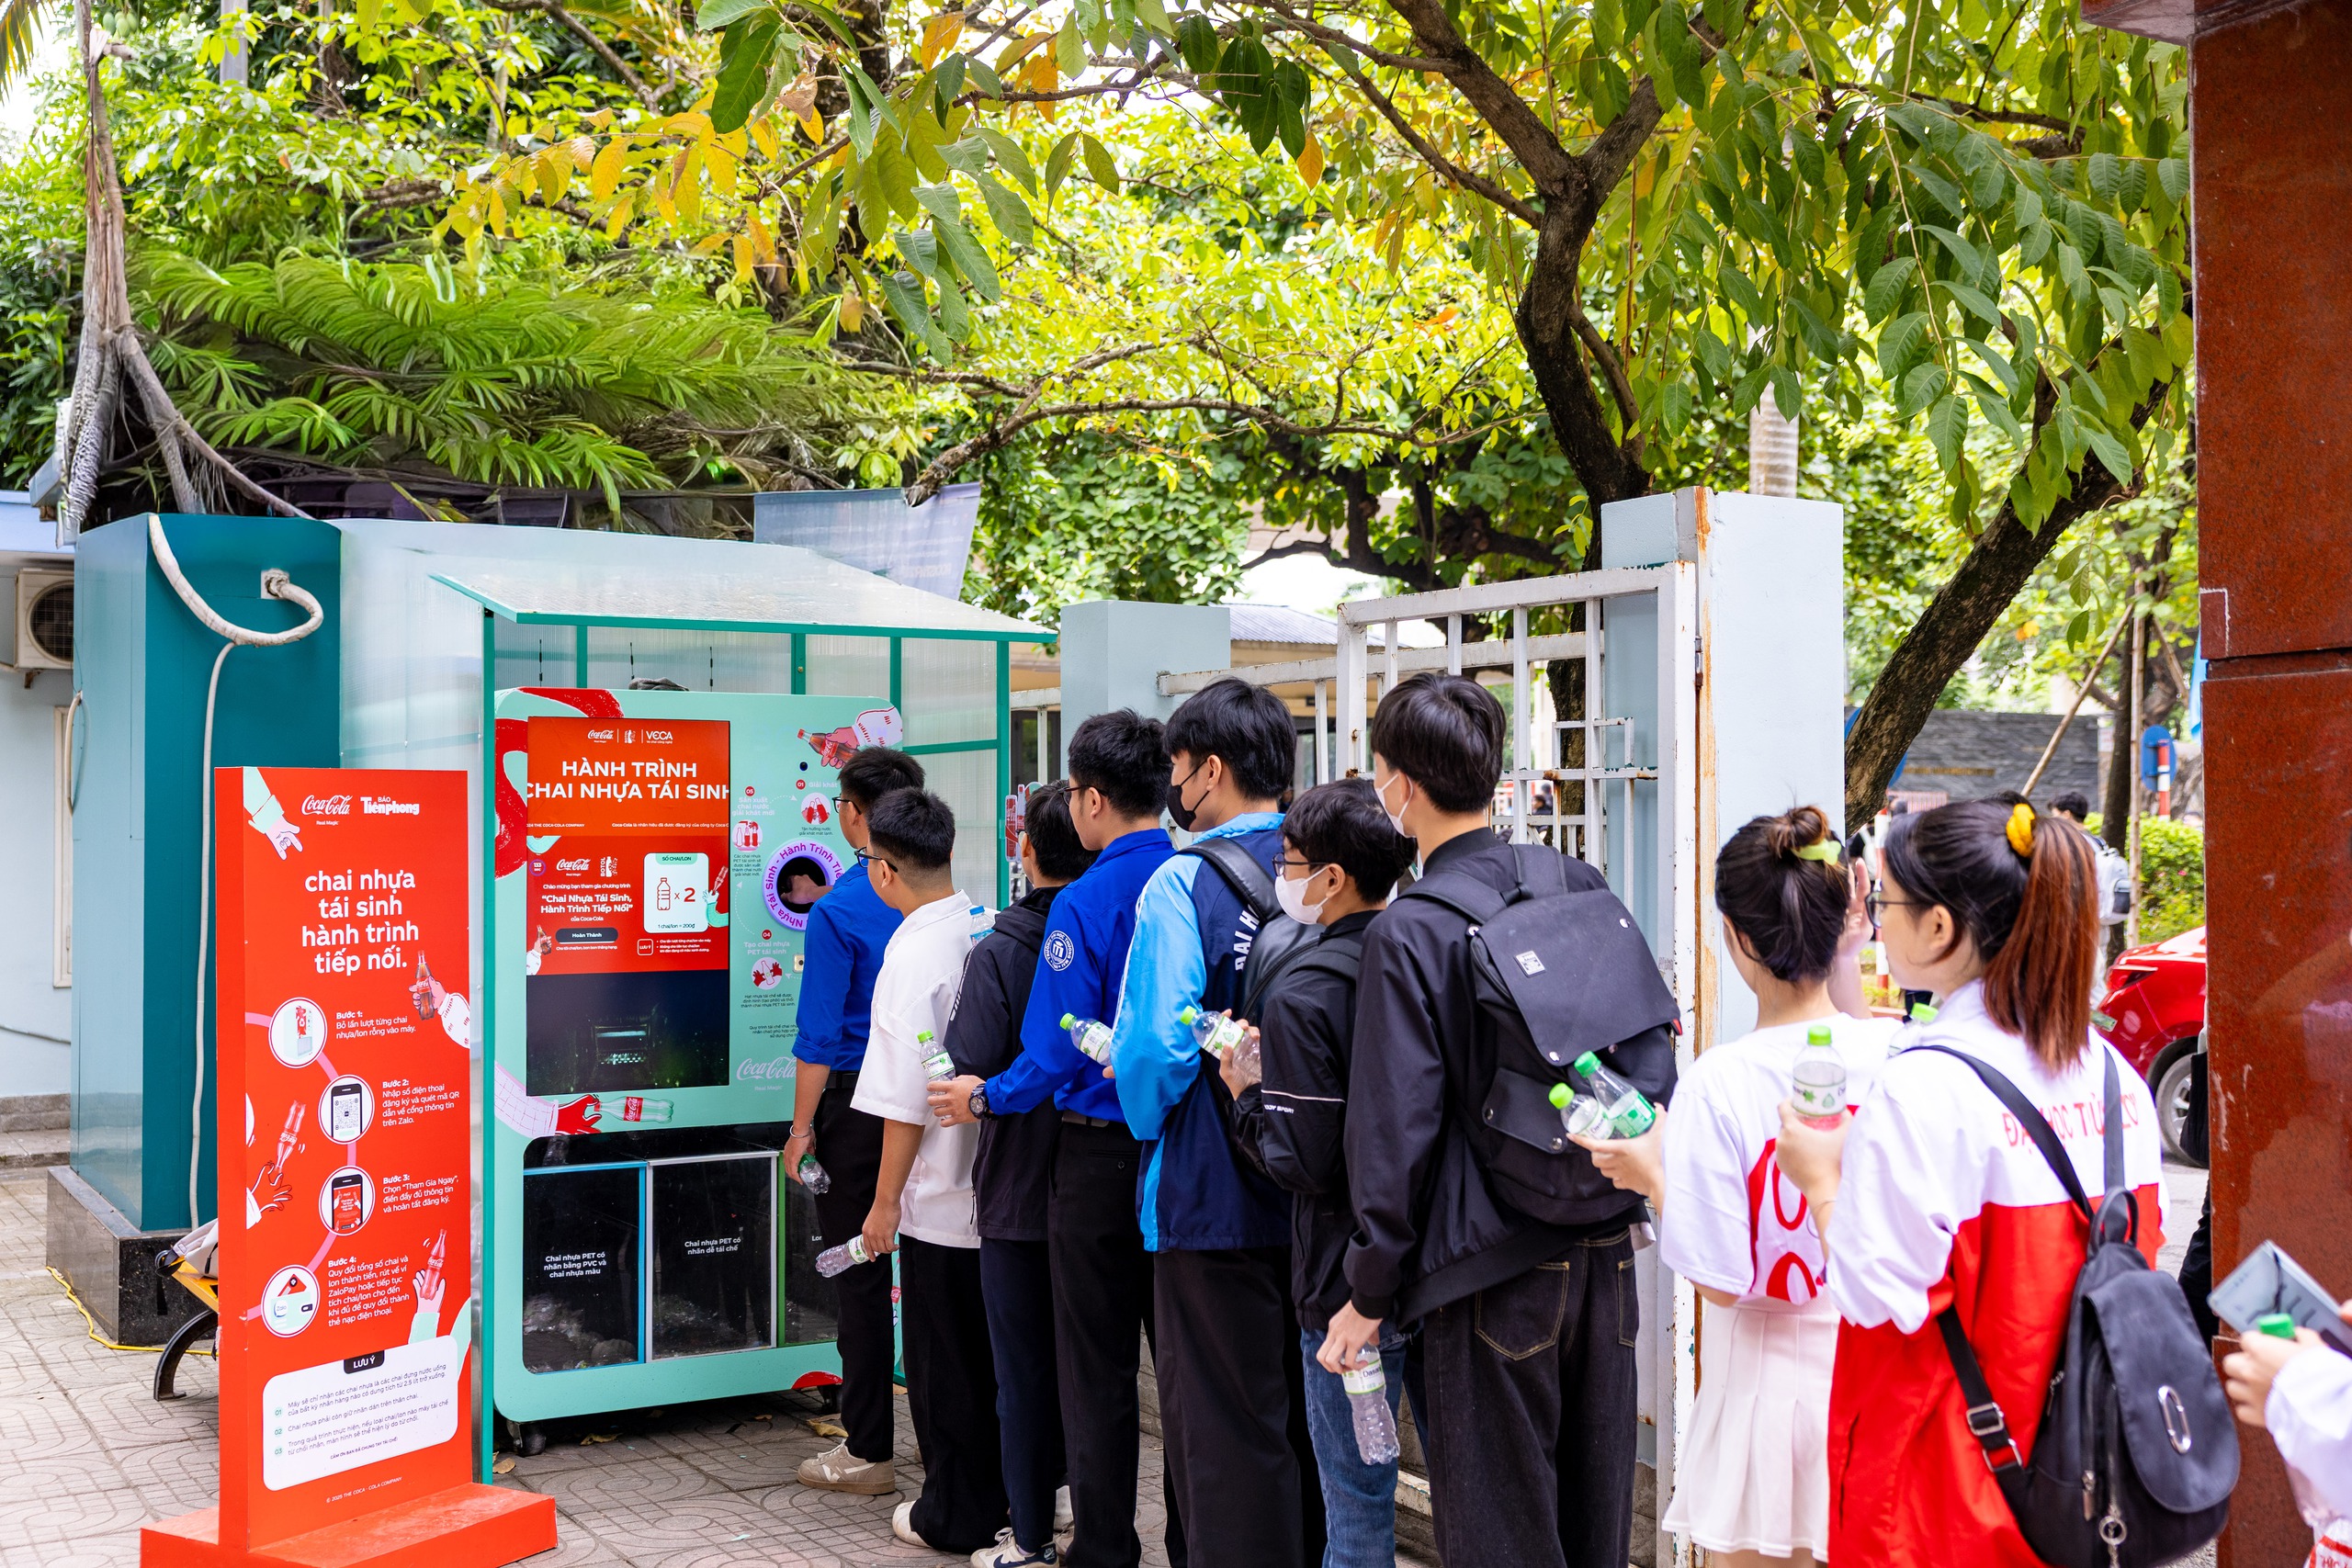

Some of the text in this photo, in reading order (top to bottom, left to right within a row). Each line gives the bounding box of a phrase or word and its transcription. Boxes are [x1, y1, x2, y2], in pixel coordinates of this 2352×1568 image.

[562, 757, 696, 777] HÀNH TRÌNH
[580, 782, 643, 803] NHỰA
[647, 781, 680, 799] TÁI
[301, 795, 353, 815] Coca-Cola
[556, 859, 591, 871] Coca-Cola
[765, 866, 777, 890] Sinh
[779, 843, 806, 859] Hành
[810, 843, 833, 862] Trình
[305, 869, 415, 894] chai nhựa
[569, 895, 593, 904] Nhựa
[594, 894, 608, 902] Tái
[684, 887, 695, 902] 2
[319, 895, 402, 919] tái sinh
[540, 905, 565, 913] Hành
[567, 905, 590, 913] Trình
[592, 904, 612, 913] Tiếp
[302, 920, 419, 947] hành trình
[314, 944, 407, 976] tiếp nối.
[336, 1011, 356, 1020] Bước
[737, 1056, 797, 1080] Coca-Cola
[382, 1080, 401, 1089] Bước
[383, 1089, 401, 1098] Nhập
[428, 1084, 445, 1092] thoại
[401, 1098, 410, 1106] ký
[421, 1095, 435, 1103] quét
[383, 1176, 401, 1184] Bước
[684, 1239, 699, 1247] Chai
[328, 1258, 347, 1268] Bước
[354, 1358, 369, 1369] LƯU
[380, 1476, 402, 1486] COMPANY
